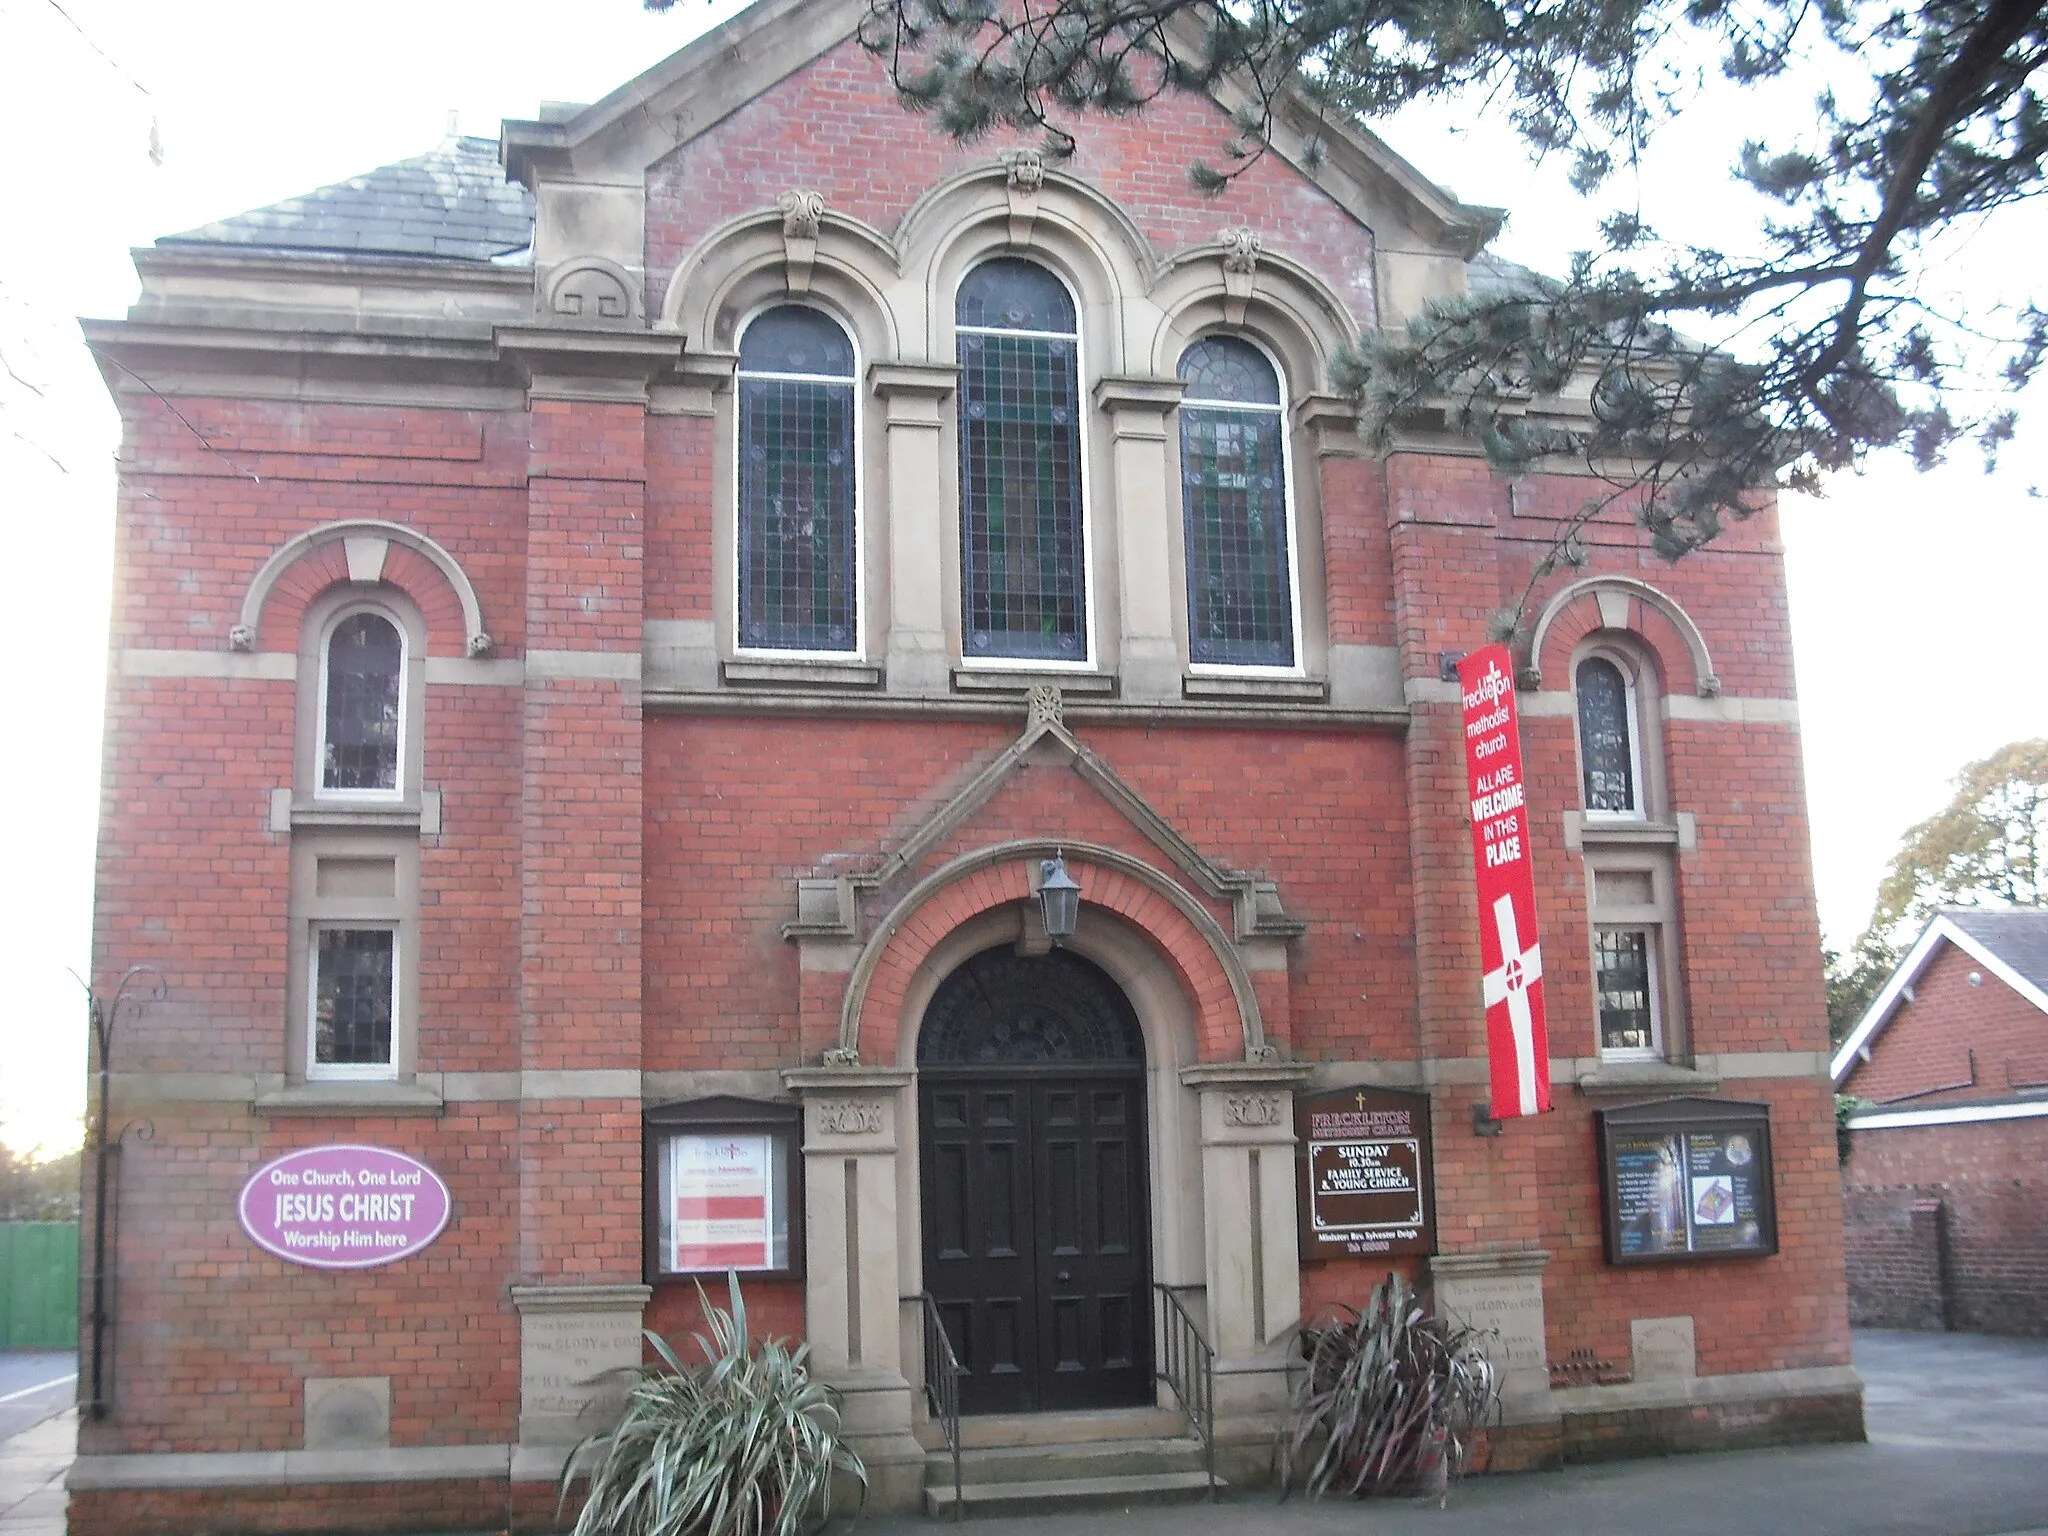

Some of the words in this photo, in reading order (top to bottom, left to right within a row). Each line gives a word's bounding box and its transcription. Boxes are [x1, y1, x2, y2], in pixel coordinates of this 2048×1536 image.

[1462, 660, 1511, 710] freckleton
[1467, 704, 1510, 738] methodist
[1475, 732, 1507, 760] church
[1477, 773, 1495, 795] ALL
[1495, 764, 1515, 788] ARE
[1471, 783, 1524, 822] WELCOME
[1483, 823, 1495, 841] IN
[1494, 815, 1519, 837] THIS
[1485, 836, 1522, 868] PLACE
[1312, 1111, 1410, 1127] FRECKLETON
[1313, 1127, 1370, 1138] METHODIST
[1372, 1125, 1412, 1136] CHAPEL
[1338, 1145, 1389, 1158] SUNDAY
[1349, 1157, 1381, 1168] 10.30am
[271, 1169, 298, 1186] One
[303, 1169, 354, 1188] Church,
[358, 1169, 386, 1186] One
[390, 1169, 421, 1186] Lord
[1321, 1180, 1331, 1190] &
[1333, 1178, 1368, 1190] YOUNG
[1369, 1177, 1409, 1188] CHURCH
[1327, 1169, 1362, 1180] FAMILY
[1364, 1167, 1402, 1179] SERVICE
[274, 1193, 334, 1228] JESUS
[339, 1193, 415, 1222] CHRIST
[284, 1231, 340, 1252] Worship
[343, 1230, 373, 1247] Him
[375, 1230, 407, 1247] here
